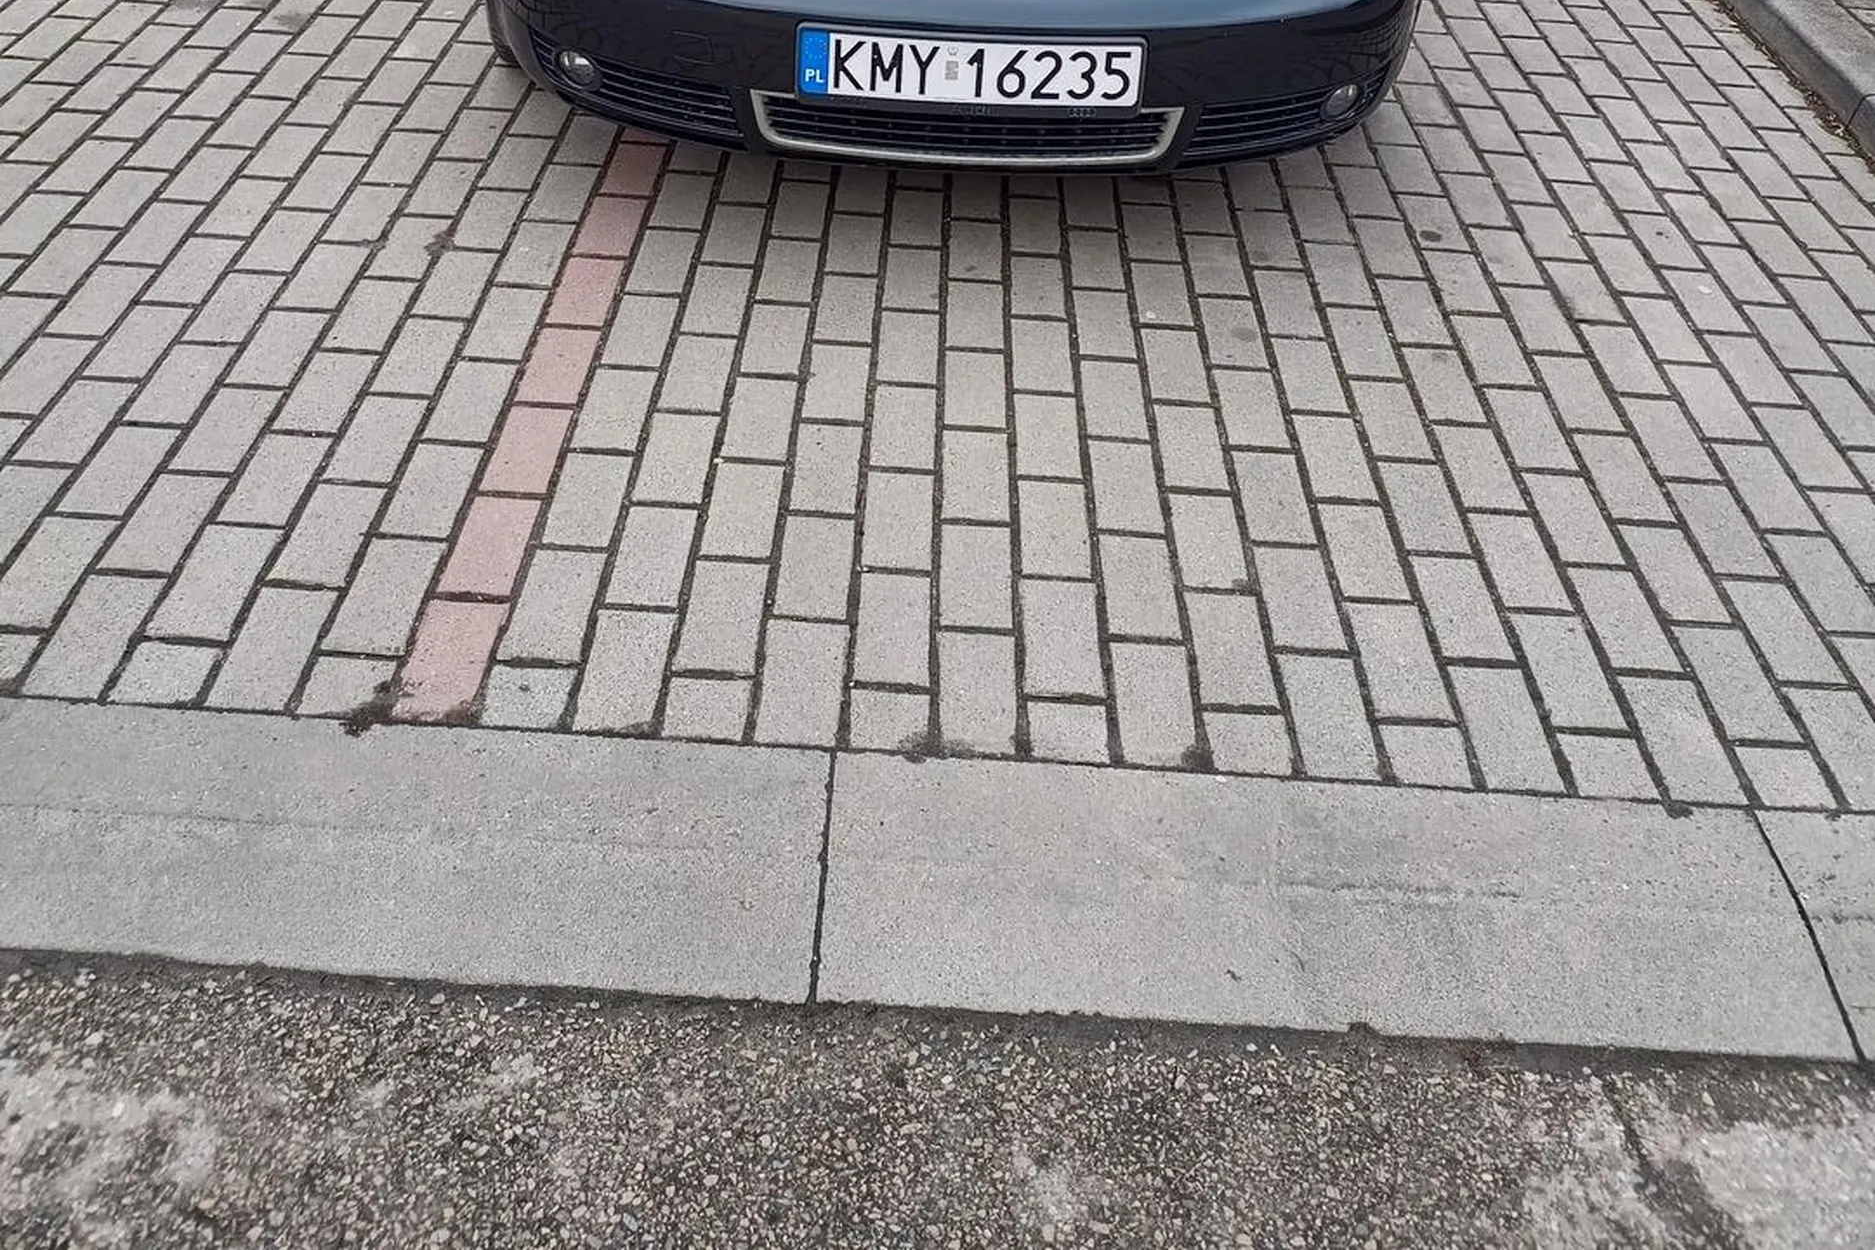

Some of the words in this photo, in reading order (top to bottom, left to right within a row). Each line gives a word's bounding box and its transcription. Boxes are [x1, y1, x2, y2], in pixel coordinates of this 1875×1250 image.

[805, 68, 825, 83] PL
[833, 39, 940, 95] KMY
[967, 49, 1132, 100] 16235
